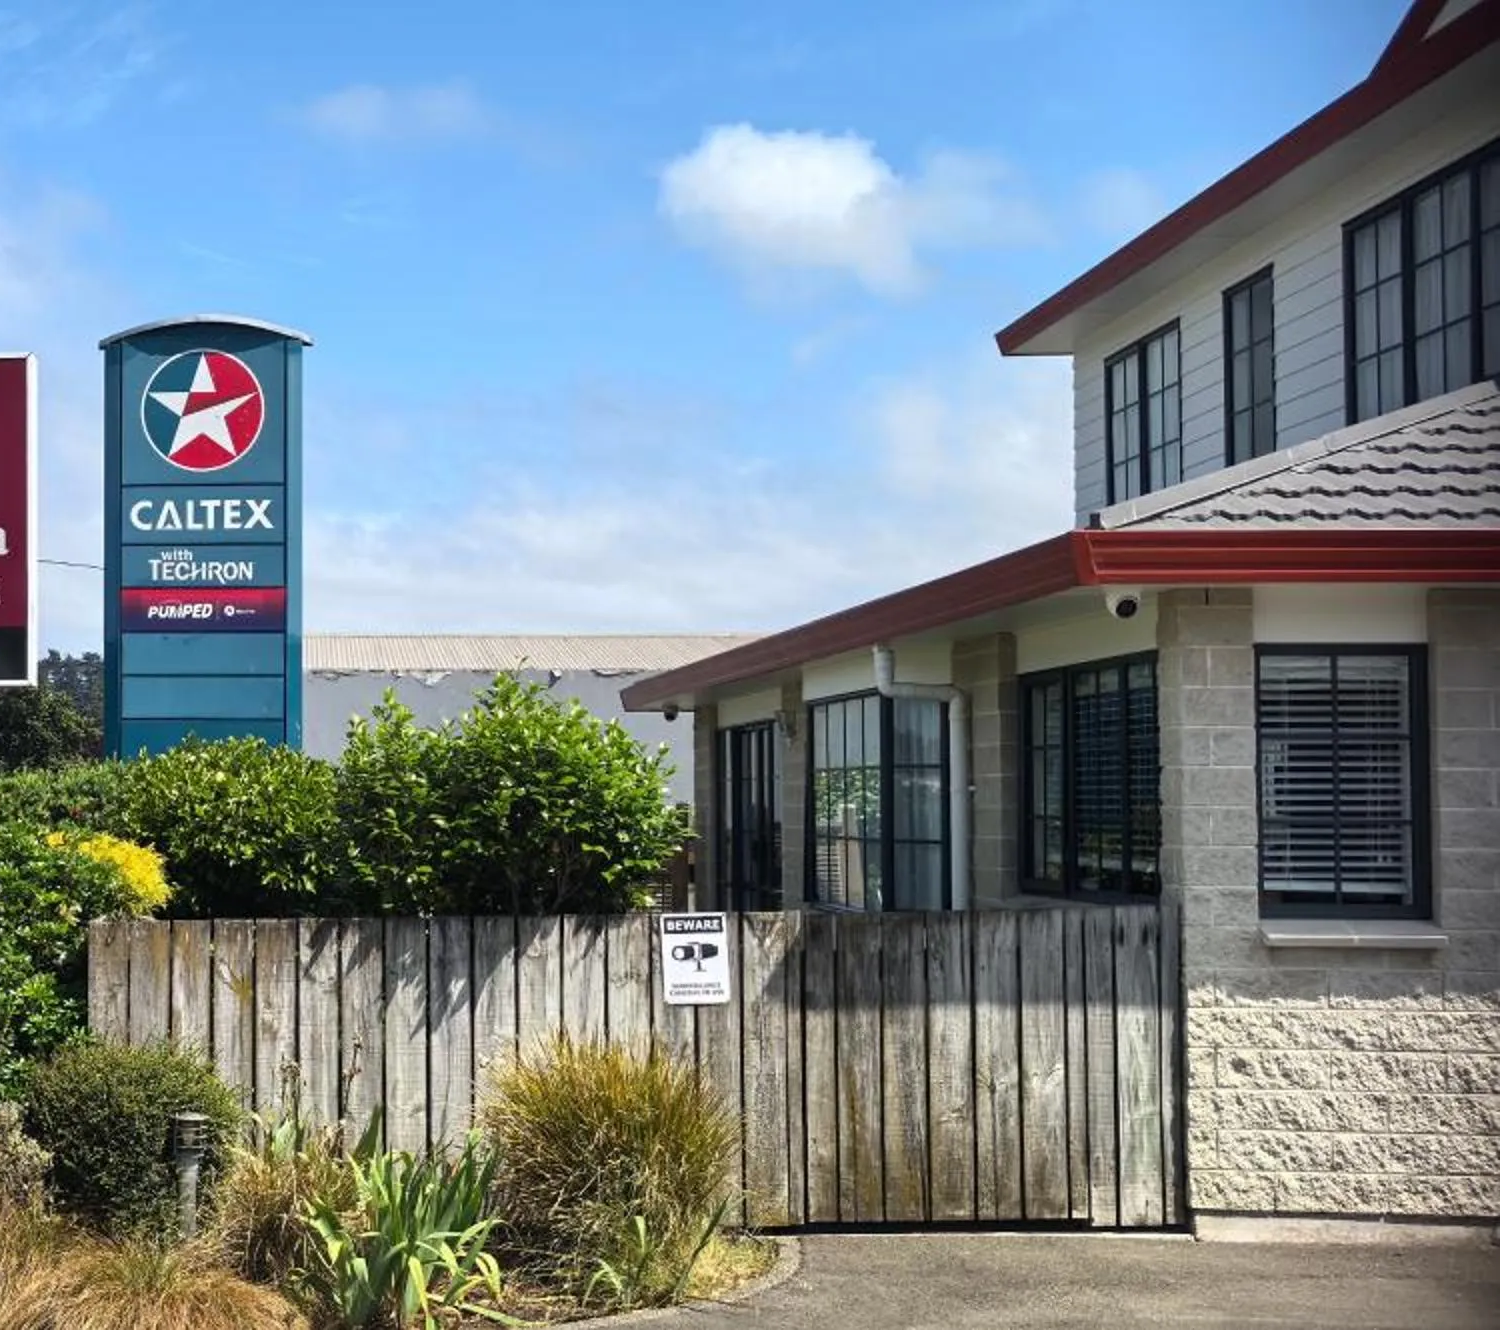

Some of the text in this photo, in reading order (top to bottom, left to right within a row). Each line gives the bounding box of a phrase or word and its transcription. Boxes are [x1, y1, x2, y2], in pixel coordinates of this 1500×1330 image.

[130, 500, 274, 530] CALTEX
[161, 548, 193, 560] with
[148, 559, 253, 585] TECHRON
[148, 603, 213, 619] PUMPED
[666, 919, 720, 931] BEWARE
